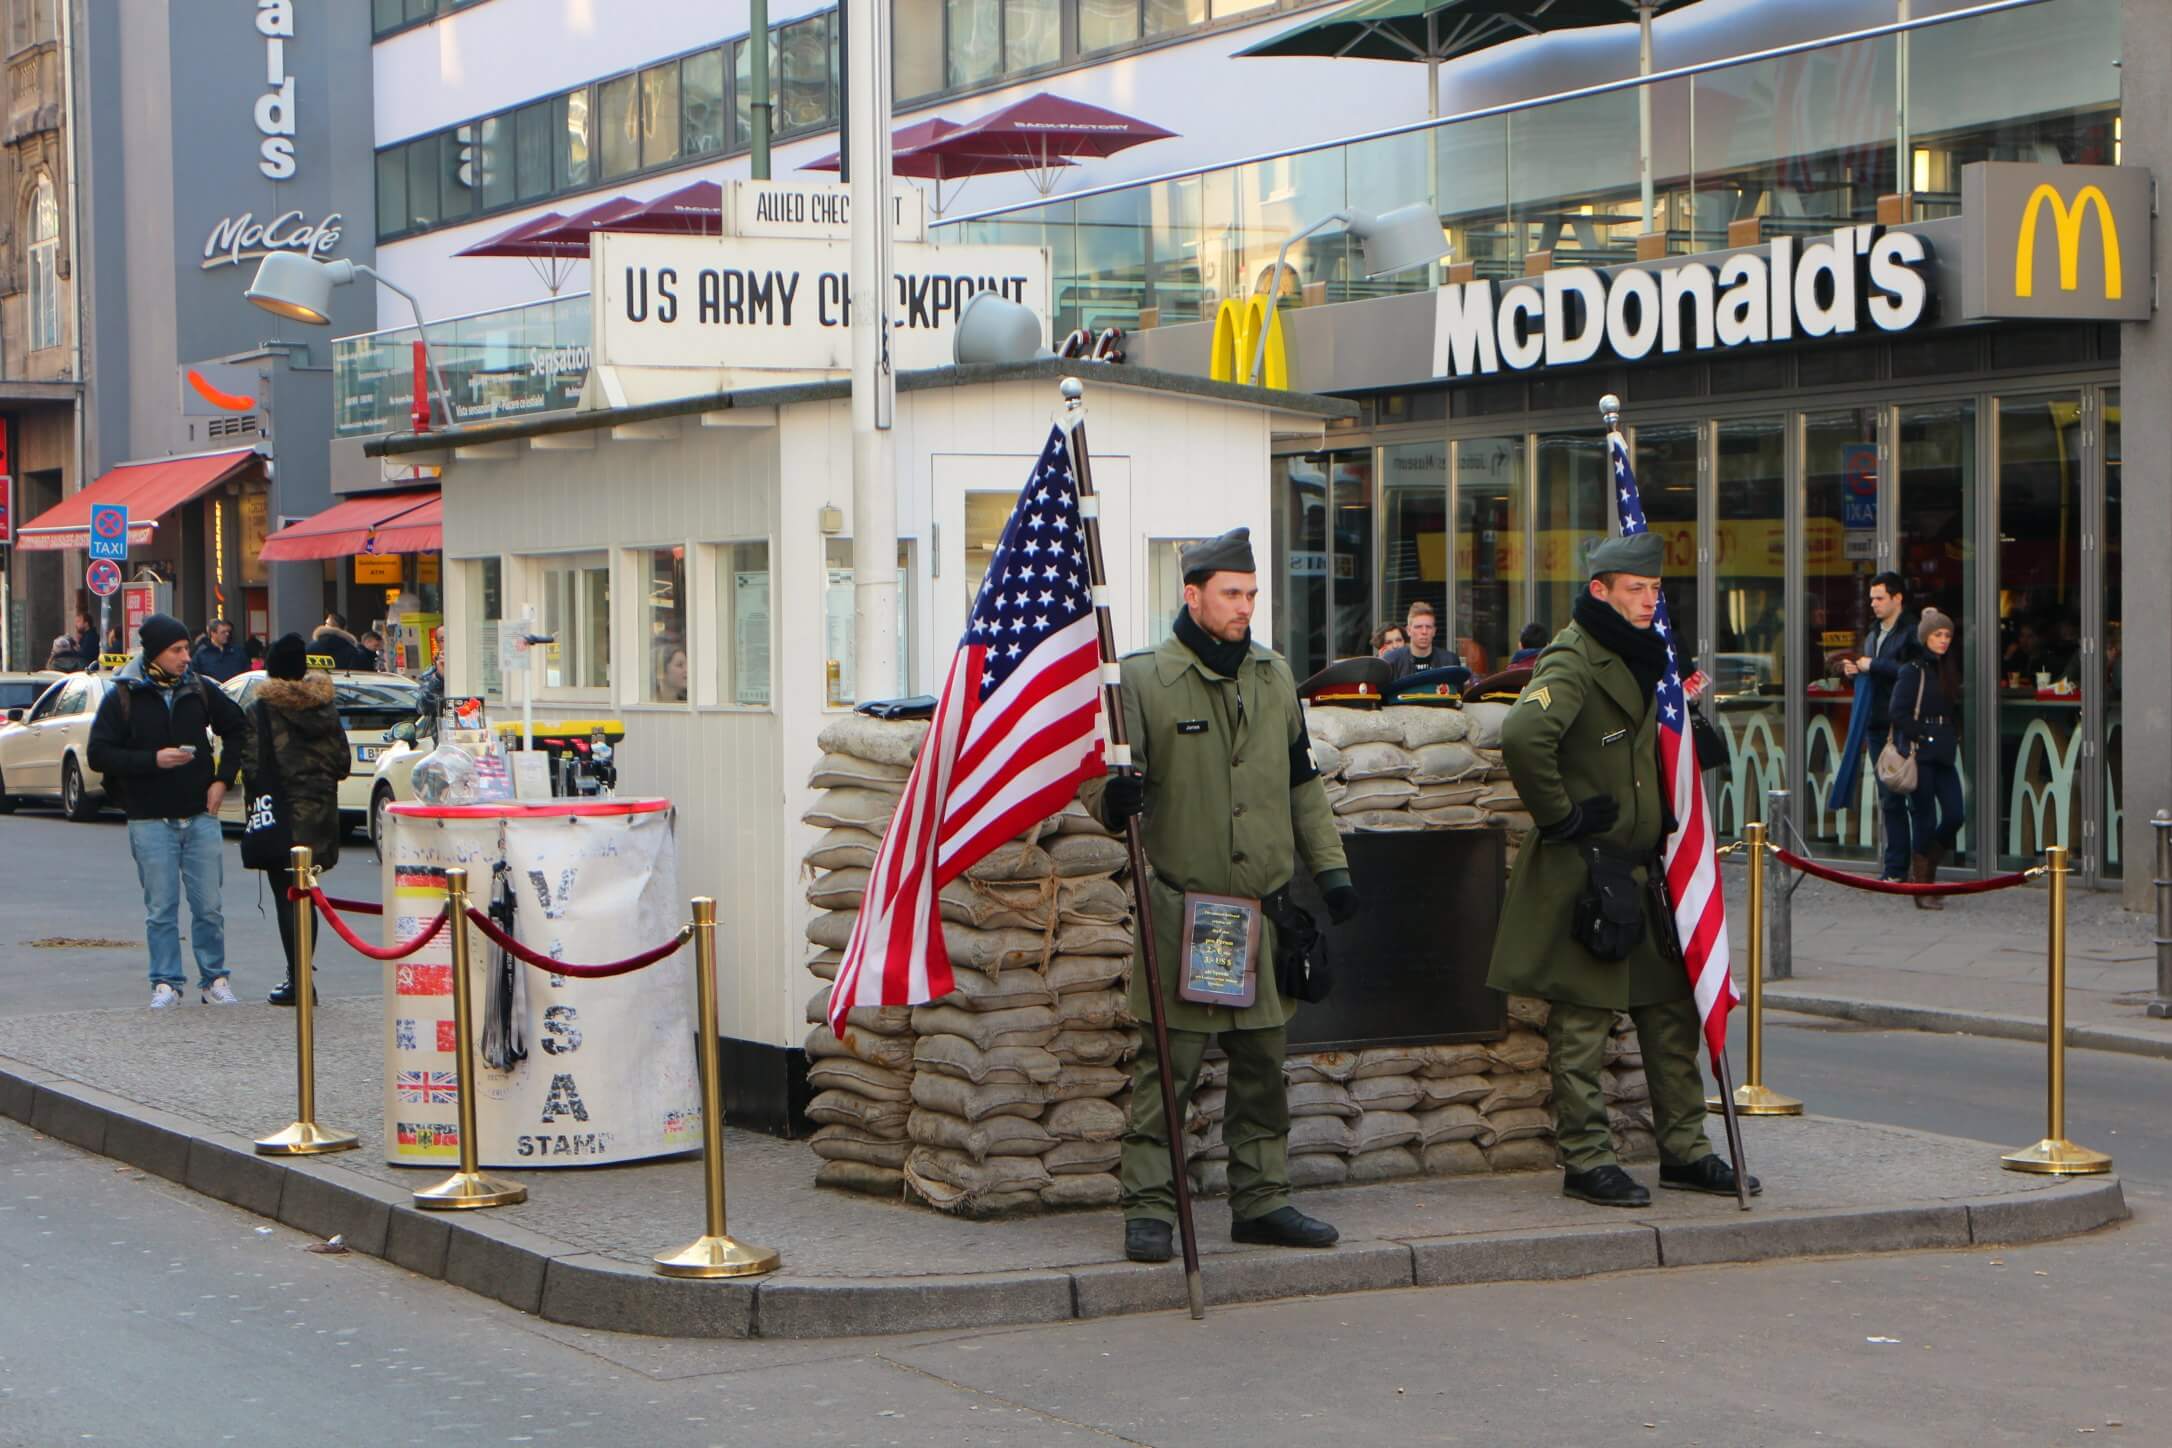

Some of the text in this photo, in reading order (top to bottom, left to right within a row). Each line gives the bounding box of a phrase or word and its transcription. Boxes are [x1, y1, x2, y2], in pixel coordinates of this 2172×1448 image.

[756, 191, 903, 226] ALLIED CHECT
[204, 210, 343, 265] McCafé
[625, 265, 1028, 329] US ARMY CHCKPOT
[1432, 223, 1927, 379] McDonald's
[93, 541, 124, 555] TAXI
